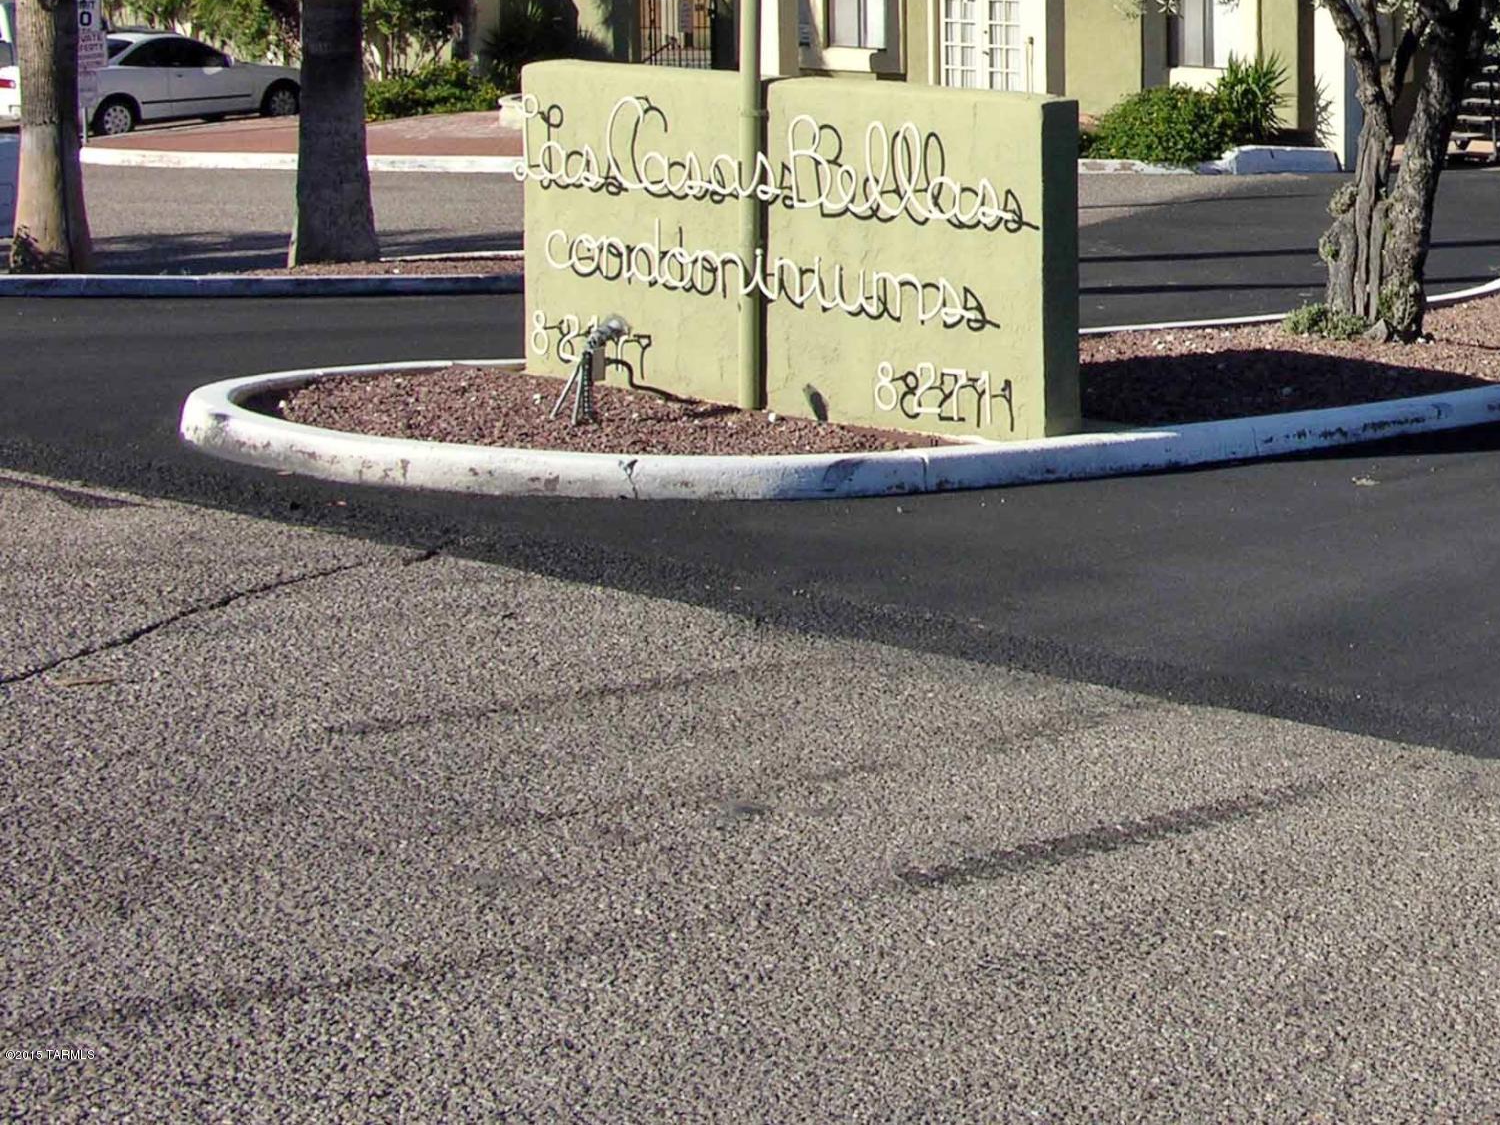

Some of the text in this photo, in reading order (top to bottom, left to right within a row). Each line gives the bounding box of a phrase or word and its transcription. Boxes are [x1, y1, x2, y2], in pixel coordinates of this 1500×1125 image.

[80, 11, 93, 27] 0
[514, 93, 1016, 223] Las Casas Bellas
[874, 361, 993, 426] 8271
